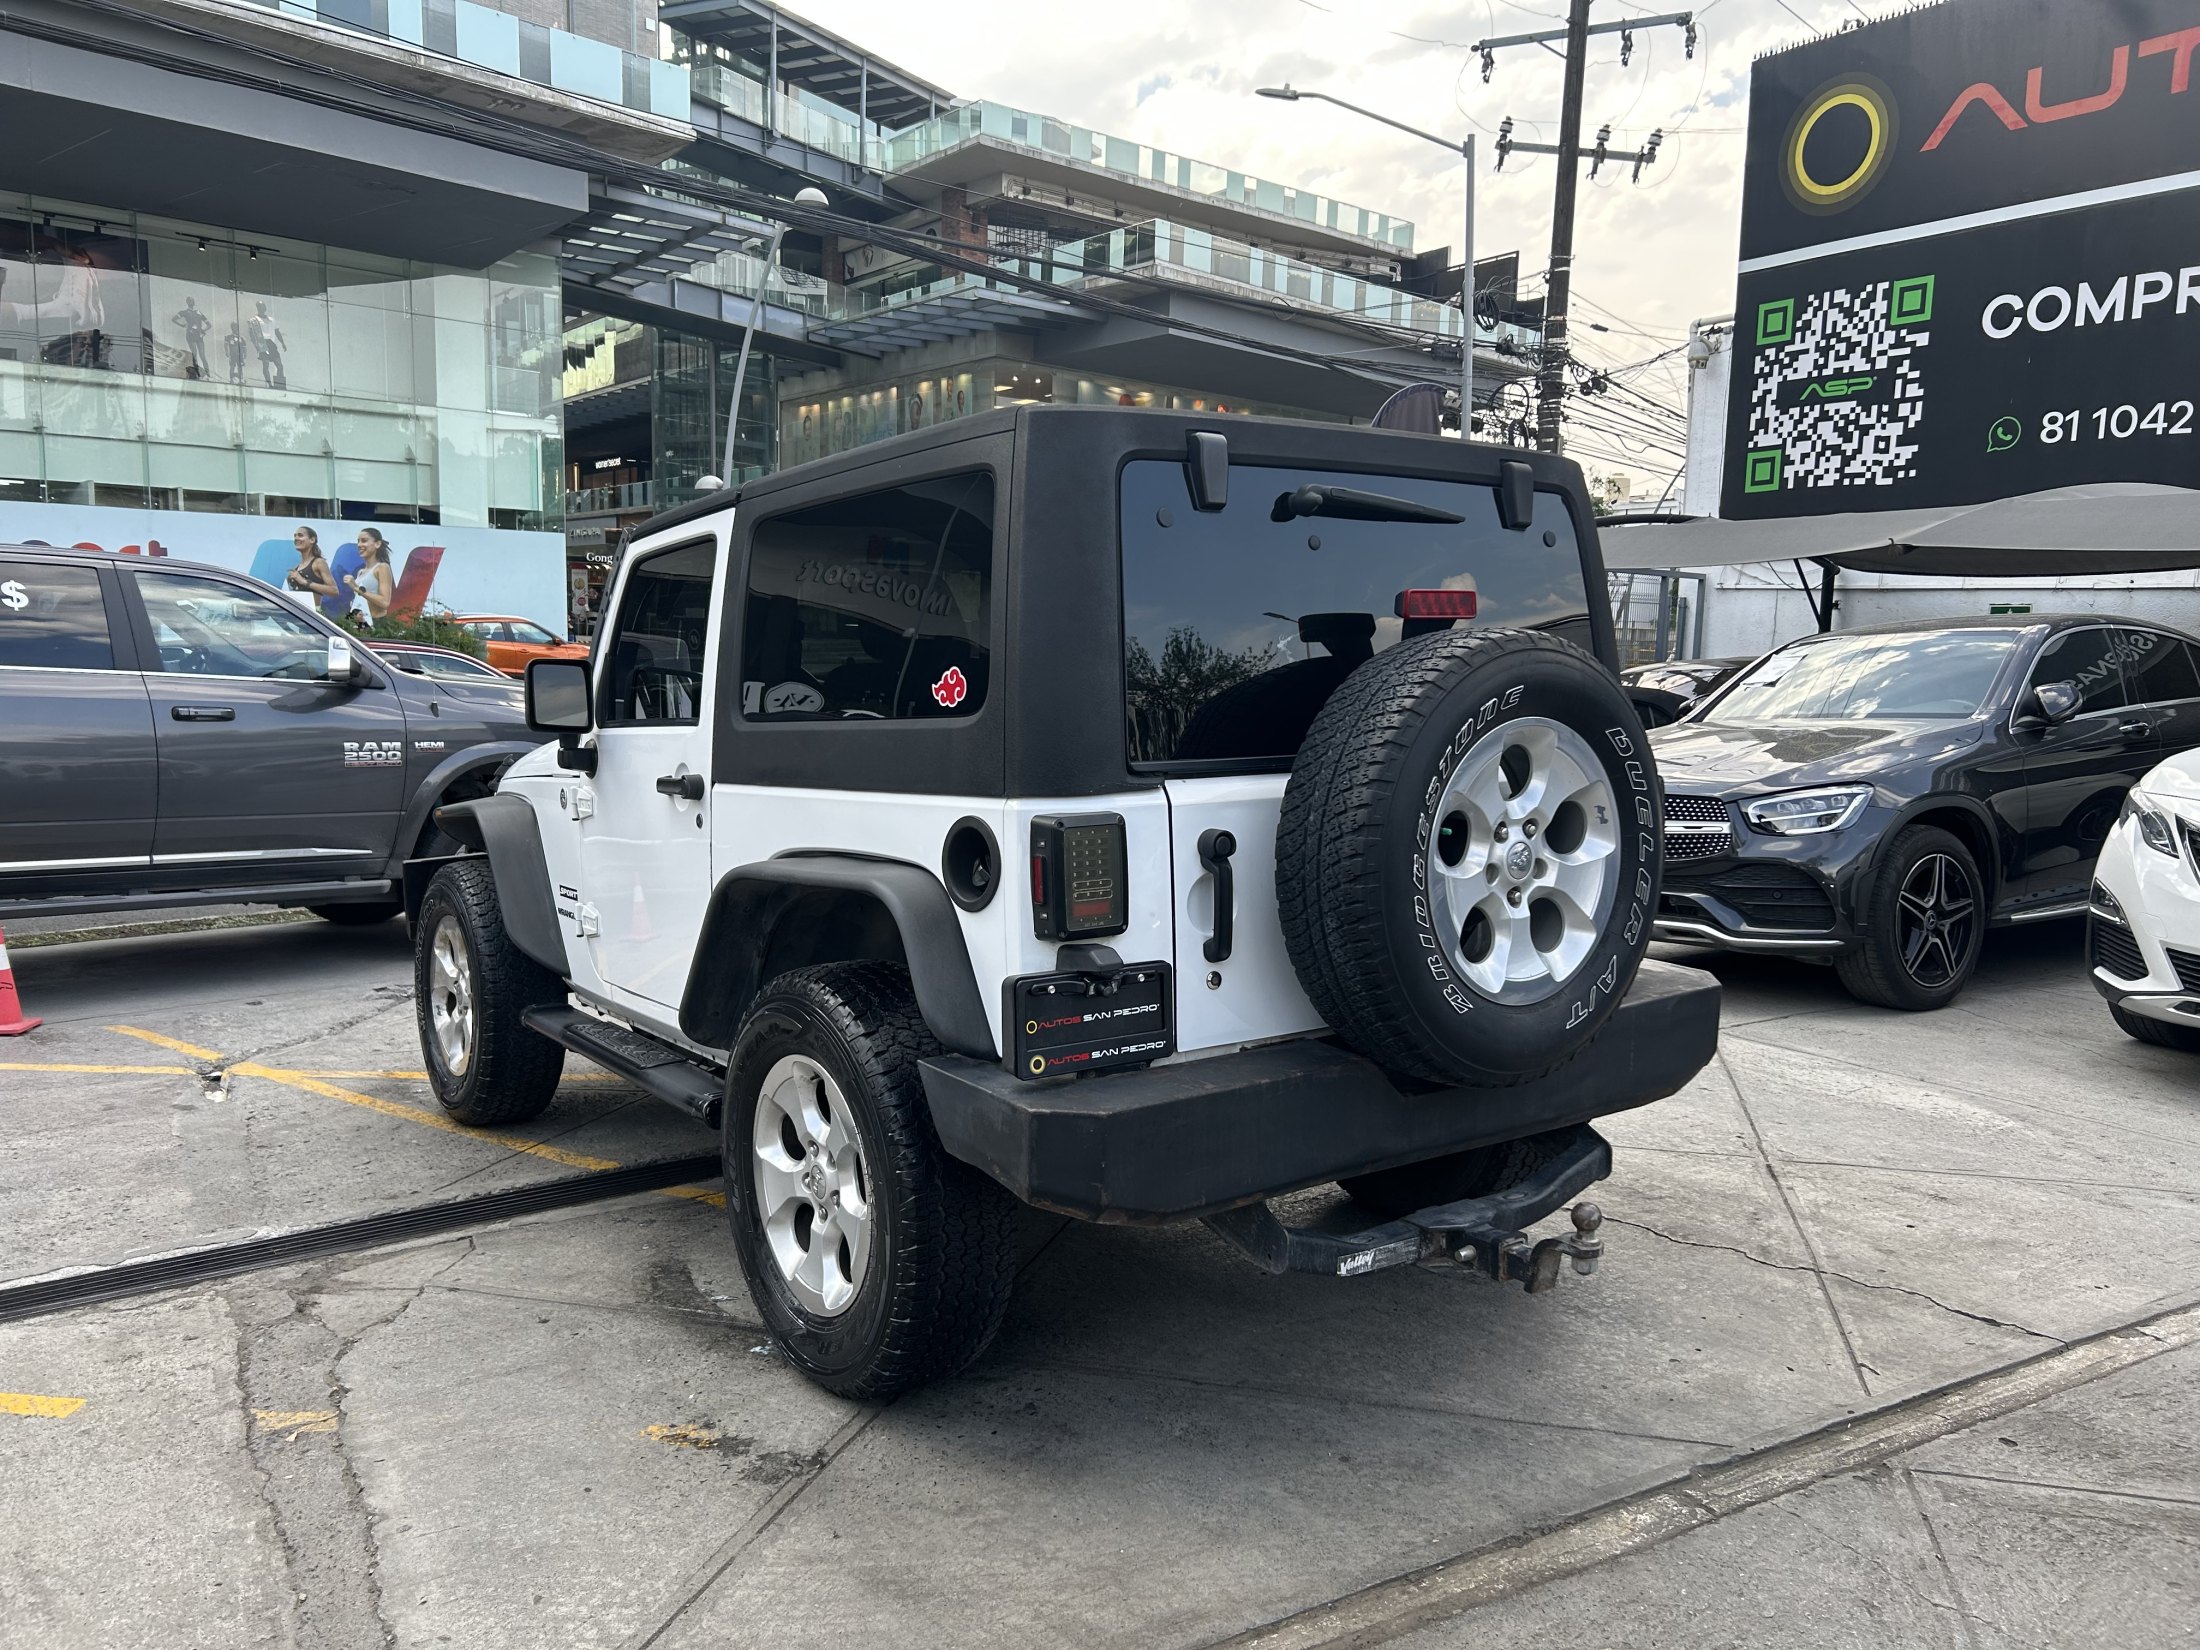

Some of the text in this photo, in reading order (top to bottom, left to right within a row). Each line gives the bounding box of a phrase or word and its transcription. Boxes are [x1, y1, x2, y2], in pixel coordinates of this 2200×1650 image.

[1920, 26, 2200, 152] AUT
[1981, 265, 2200, 339] COMPR
[1800, 376, 1874, 400] ASP
[2040, 400, 2194, 443] 81 1042
[586, 552, 614, 564] Gong
[343, 741, 402, 751] RAM
[344, 751, 402, 761] 2500
[1413, 684, 1525, 1014] BRIDGESTONE
[1566, 727, 1654, 1029] DUELER A/T
[559, 885, 579, 902] SPORT
[1038, 1004, 1158, 1030] AUTOS SAN PEDRO
[1047, 1041, 1164, 1066] AUTOS SAN PEDRO
[1340, 1250, 1376, 1274] Valley
